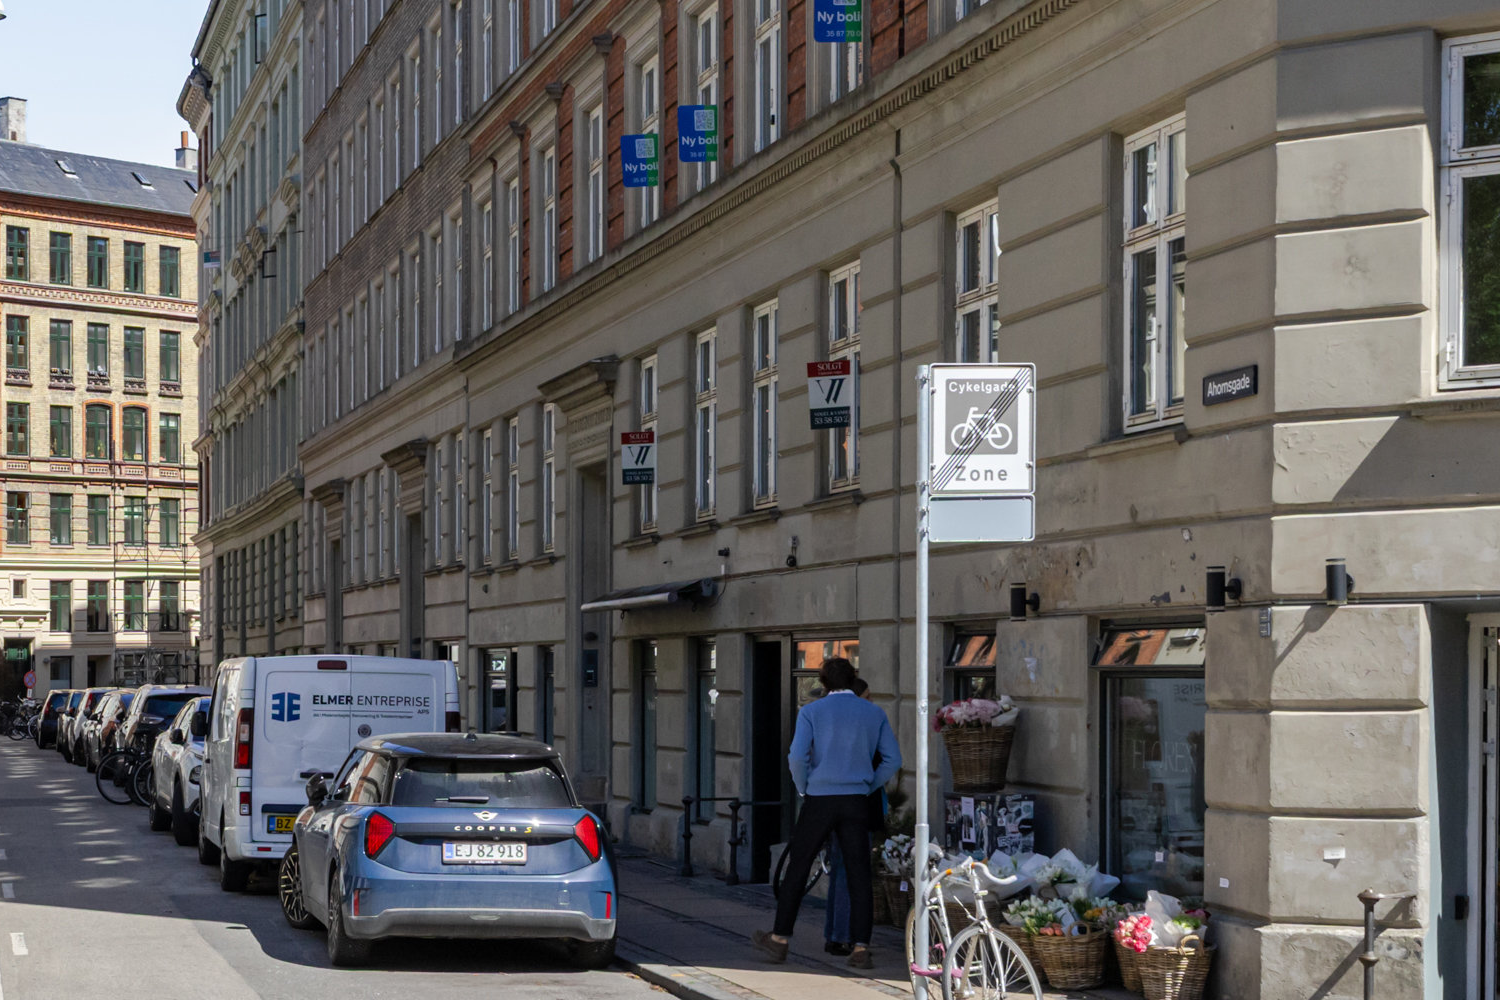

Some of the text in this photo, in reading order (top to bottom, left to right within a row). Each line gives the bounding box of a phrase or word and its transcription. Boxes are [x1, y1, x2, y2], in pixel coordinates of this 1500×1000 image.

[817, 11, 862, 24] Ny boli
[681, 136, 718, 148] Ny boli
[625, 162, 658, 174] Ny boli
[817, 362, 843, 371] SOLGT
[955, 465, 1008, 481] Zone
[312, 694, 430, 708] ELMER ENTREPRISE
[455, 844, 524, 858] EJ 82 918
